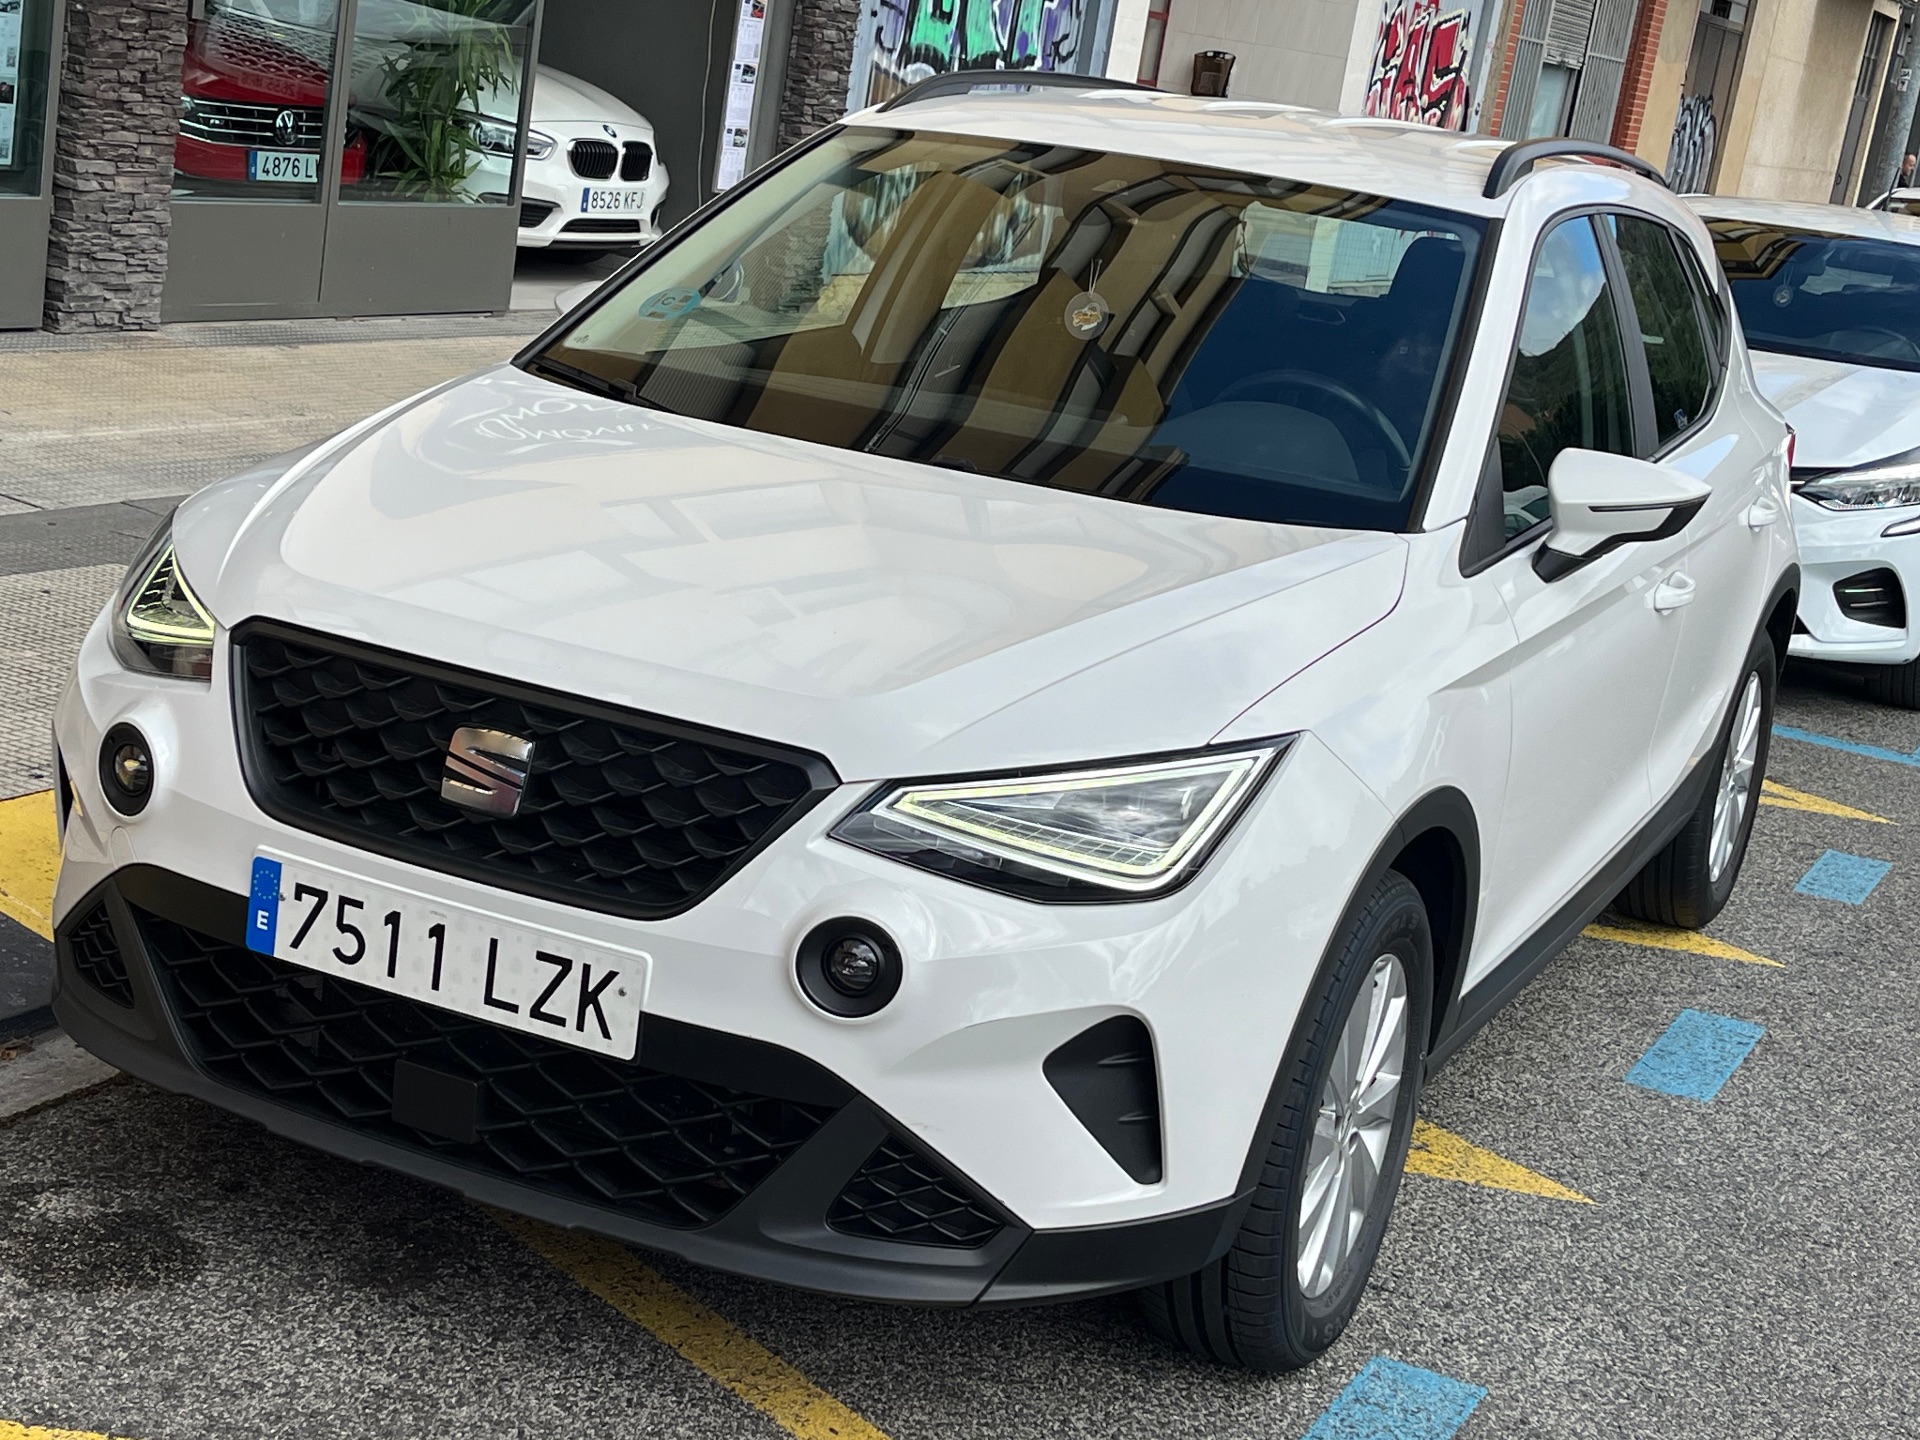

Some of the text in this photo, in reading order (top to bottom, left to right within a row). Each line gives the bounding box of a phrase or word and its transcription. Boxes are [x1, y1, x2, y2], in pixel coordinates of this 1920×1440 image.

[262, 156, 319, 179] 4876 L
[591, 190, 645, 210] 8526 KFJ
[256, 909, 269, 931] E
[289, 882, 620, 1041] 7511 LZK
